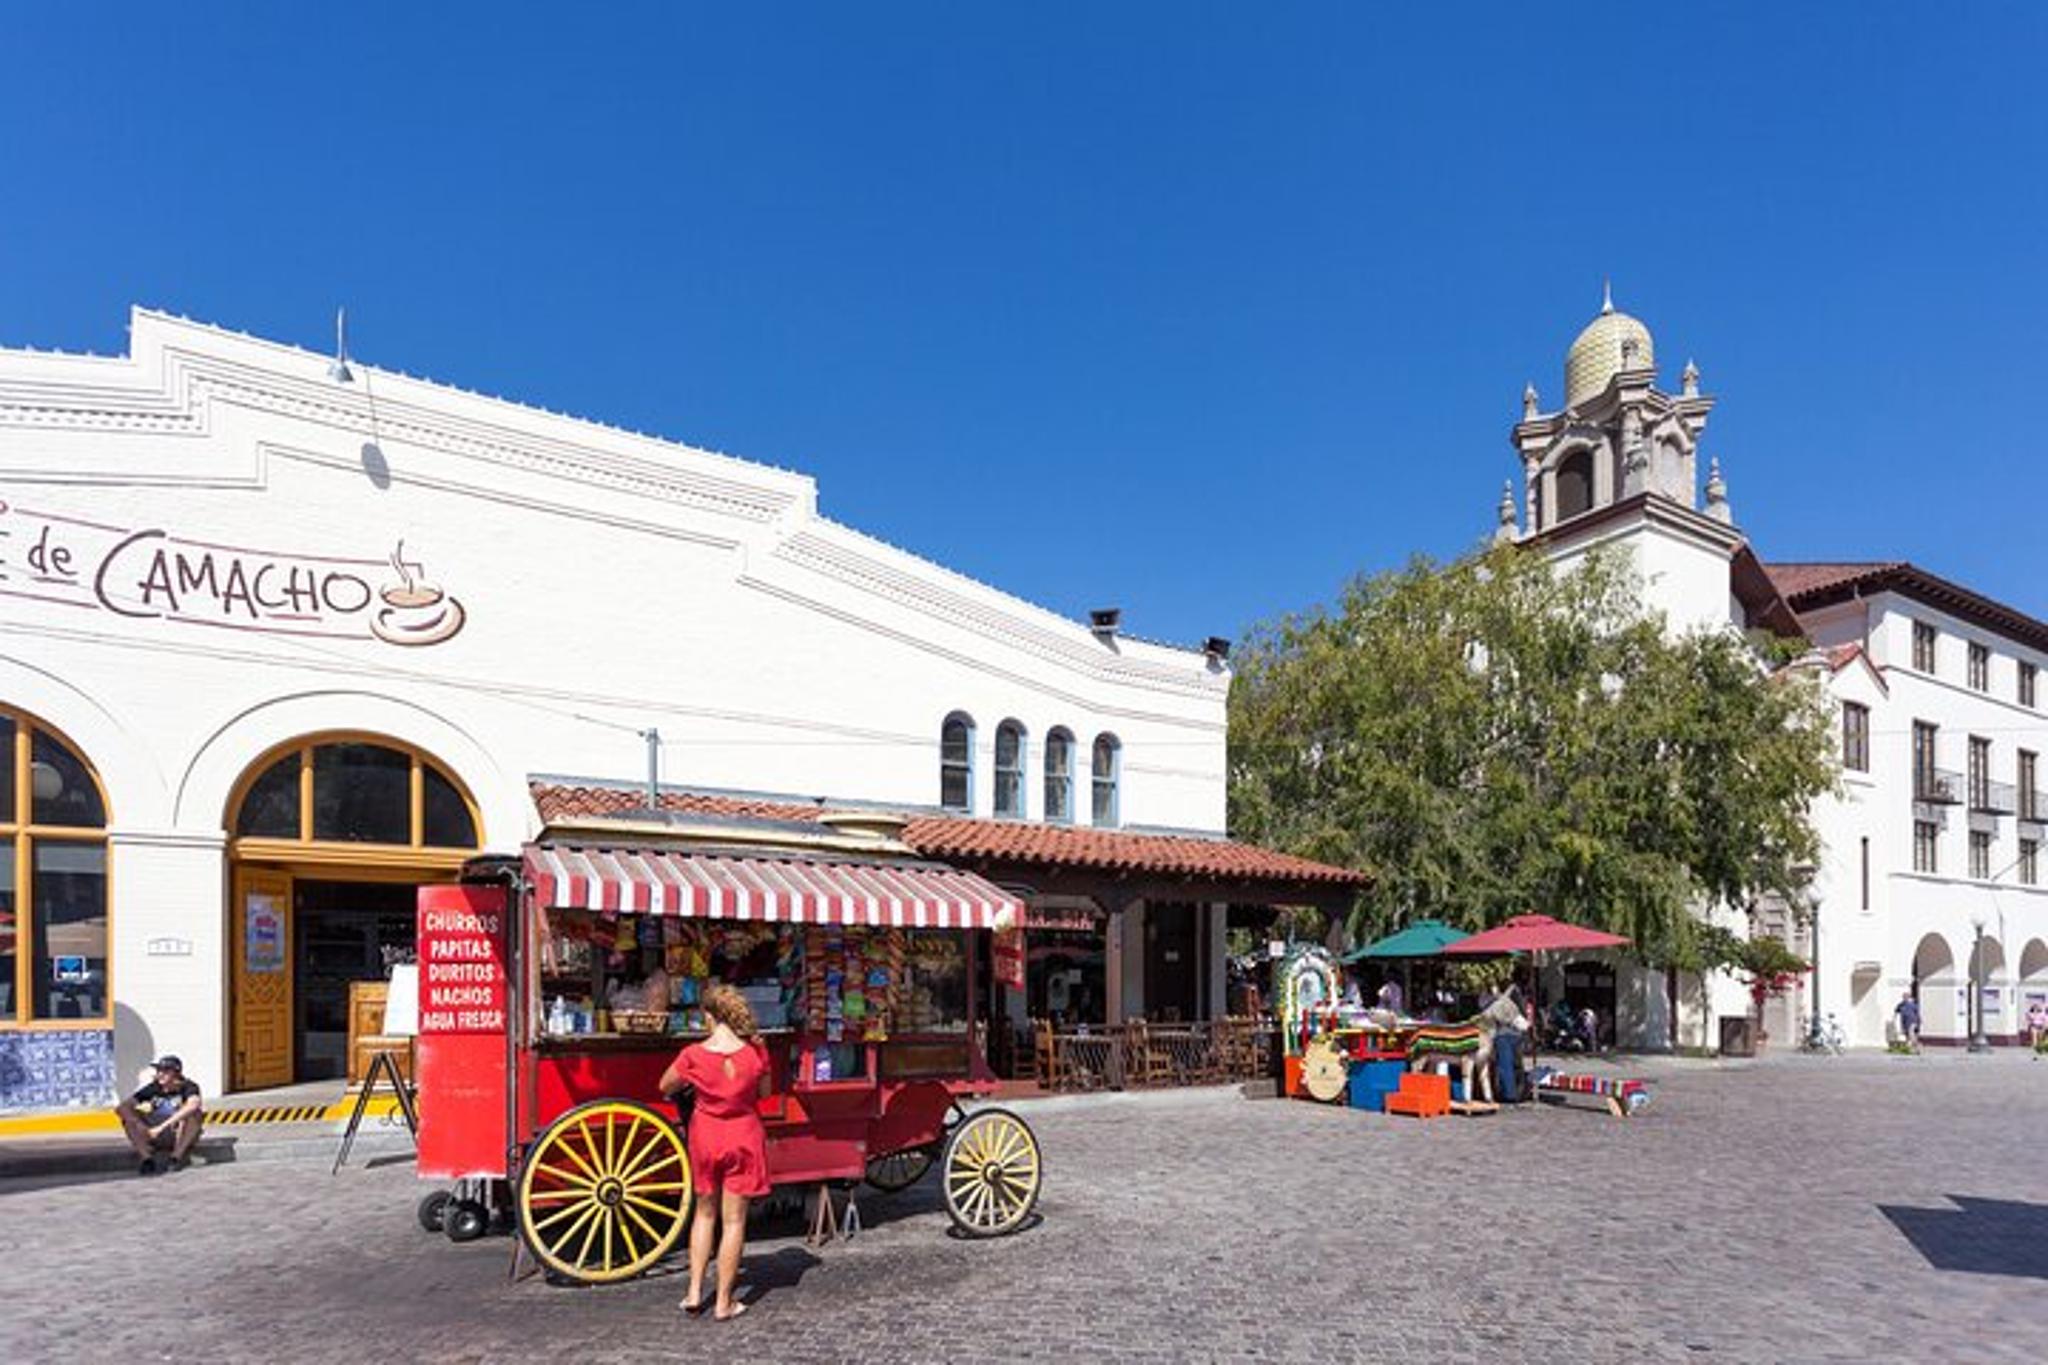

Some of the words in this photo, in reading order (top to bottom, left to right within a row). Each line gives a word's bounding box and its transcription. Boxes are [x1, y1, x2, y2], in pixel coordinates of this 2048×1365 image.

[28, 525, 78, 576] de
[94, 529, 371, 618] CAMACHO
[426, 911, 498, 933] CHURROS
[431, 939, 492, 959] PAPITAS
[428, 962, 494, 982] DURITOS
[431, 986, 493, 1006] NACHOS
[423, 1011, 456, 1030] AGUA
[458, 1009, 504, 1030] FRESCA
